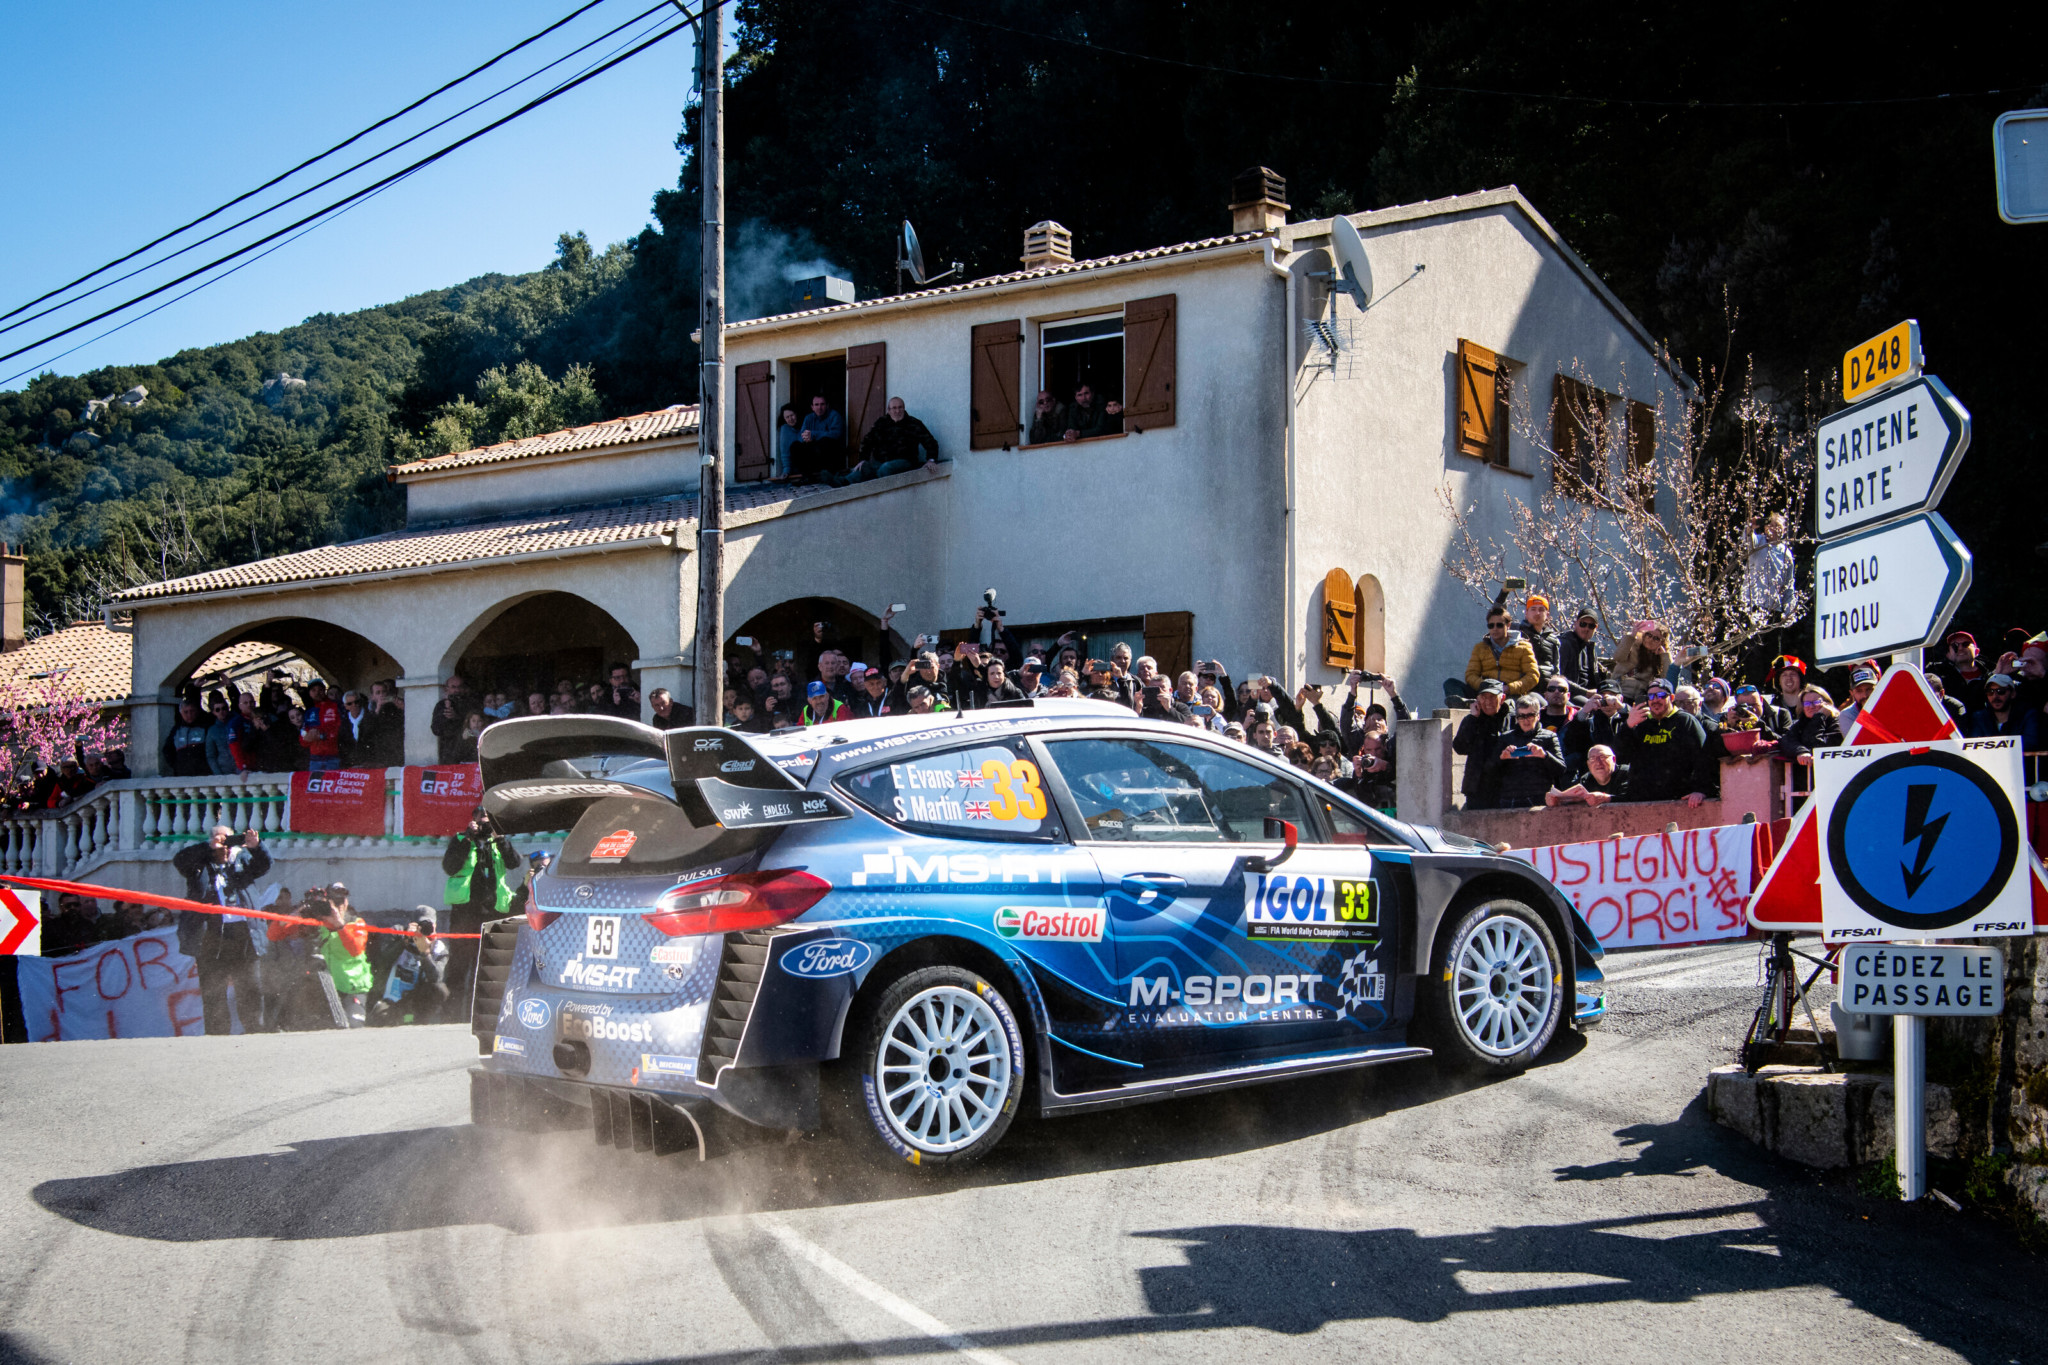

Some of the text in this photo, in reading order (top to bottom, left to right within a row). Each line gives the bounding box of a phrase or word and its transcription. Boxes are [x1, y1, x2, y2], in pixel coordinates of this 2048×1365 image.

[1824, 403, 1919, 470] SARTENE
[1822, 555, 1879, 597] TIROLO
[1821, 602, 1880, 640] TIROLU
[720, 759, 756, 773] Eibach
[777, 754, 814, 768] Stilo
[308, 779, 334, 793] GR
[420, 780, 449, 795] GR
[890, 764, 955, 790] E Evans
[981, 759, 1048, 821] 33
[724, 806, 748, 820] SWP
[802, 798, 828, 810] NGK
[893, 796, 962, 822] S Martin
[677, 867, 723, 884] PULSAR
[1254, 875, 1327, 922] IGOL
[1340, 881, 1370, 921] 33
[1022, 910, 1099, 938] Castrol
[1270, 926, 1280, 935] FIA
[1281, 926, 1298, 935] World
[1298, 927, 1313, 937] Rally
[1313, 928, 1350, 937] Championship
[1452, 909, 1486, 957] MICHELIN
[592, 920, 615, 956] 33
[657, 949, 690, 962] Castrol
[799, 942, 857, 974] Ford
[1855, 950, 1993, 978] CÉDEZ LE
[1130, 974, 1323, 1007] M-SPORT
[1360, 976, 1376, 998] M
[1853, 984, 1993, 1007] PASSAGE
[521, 1001, 545, 1024] Ford
[564, 1001, 614, 1018] Powered by
[1129, 1009, 1324, 1024] EVALUATION CENTRE
[993, 1000, 1021, 1068] MICHELIN
[658, 1060, 692, 1071] MICHELIN
[865, 1081, 900, 1149] MICHELIN
